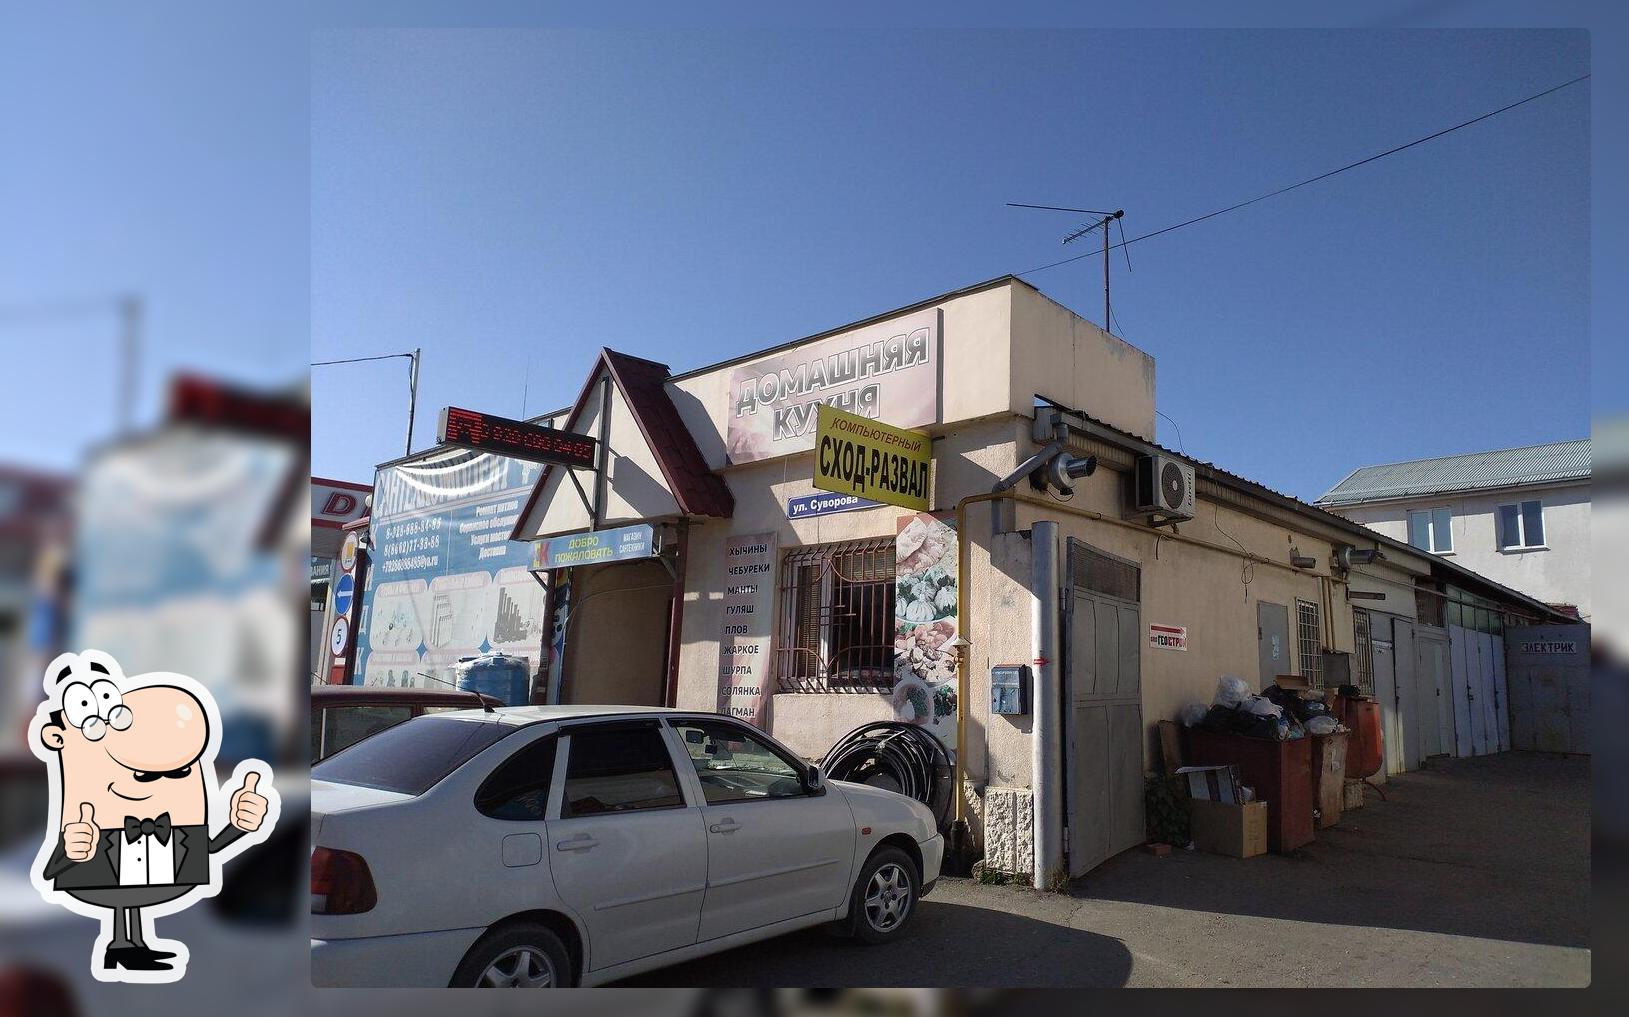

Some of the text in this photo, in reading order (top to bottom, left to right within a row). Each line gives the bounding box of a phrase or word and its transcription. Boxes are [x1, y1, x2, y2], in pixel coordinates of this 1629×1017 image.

[736, 327, 930, 418] ДОМАШНЯЯ
[830, 417, 922, 453] КОМПЬЮТЕРНЫЙ
[818, 434, 928, 500] СХОД-РАЗВАЛ
[792, 496, 858, 515] ул. Суворова
[568, 536, 599, 549] ДОБРО
[554, 547, 613, 564] ПОЖАЛОВАТЬ
[728, 544, 768, 556] ХЫЧИНЫ
[728, 564, 770, 575] ЧЕБУРЕКИ
[727, 585, 758, 595] МАНТЫ
[726, 605, 754, 615] ГУЛЯШ
[725, 625, 748, 635] ПЛОВ
[335, 629, 342, 645] 5
[723, 645, 759, 655] ЖАРКОЕ
[1521, 642, 1574, 653] ЭЛЕКТРИК
[722, 666, 752, 675] ШУРПА
[721, 686, 761, 696] СОЛЯНКА
